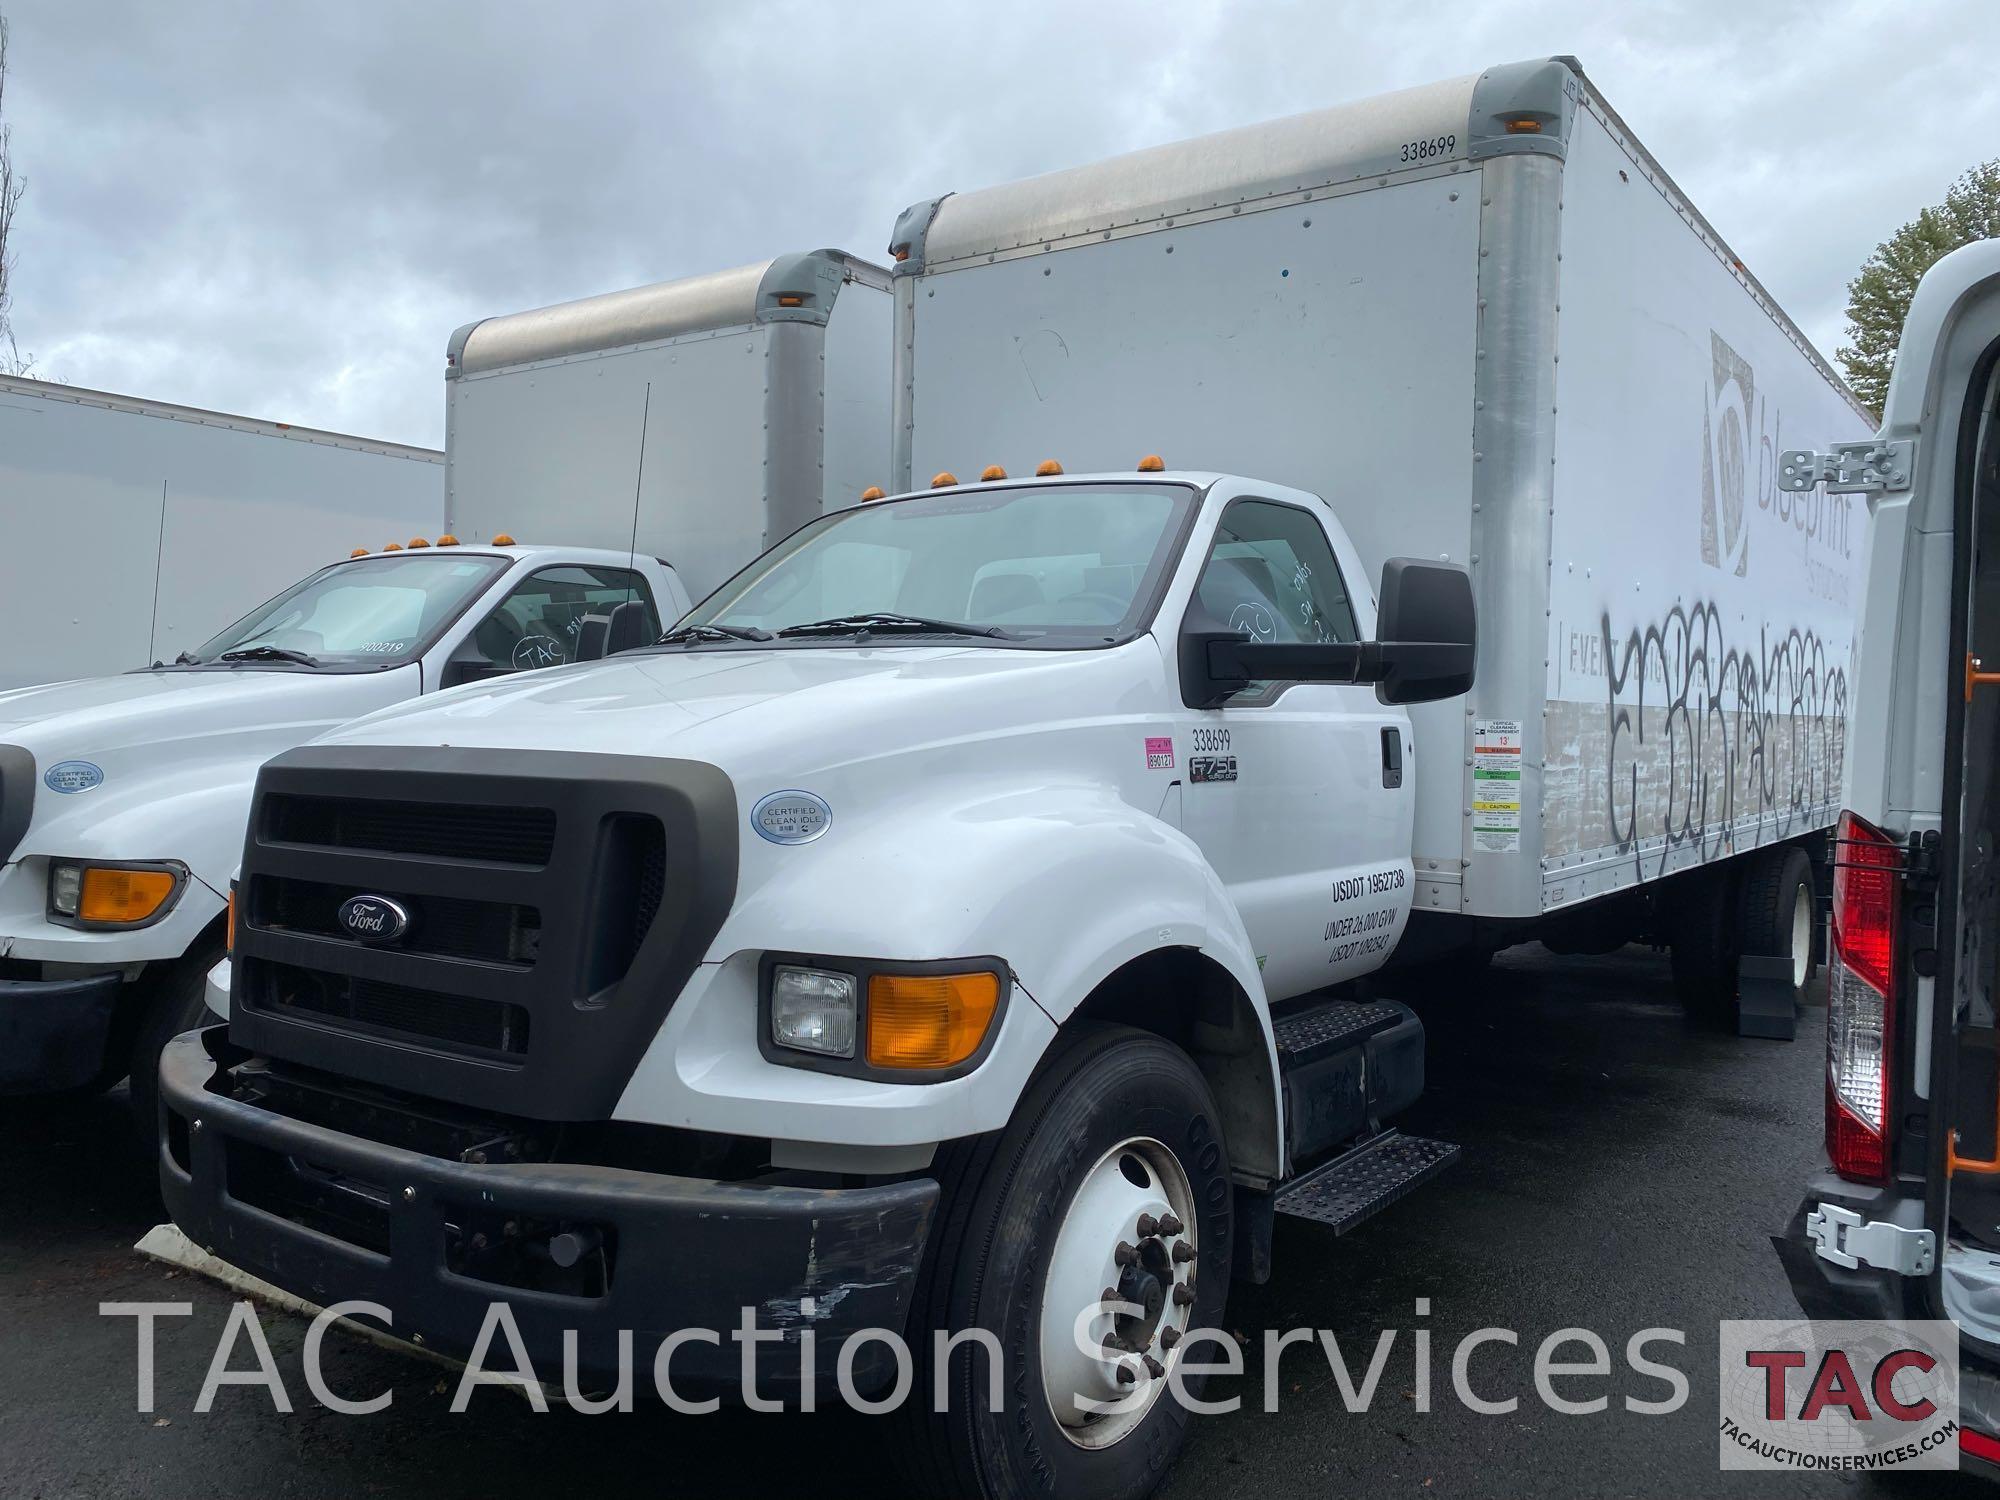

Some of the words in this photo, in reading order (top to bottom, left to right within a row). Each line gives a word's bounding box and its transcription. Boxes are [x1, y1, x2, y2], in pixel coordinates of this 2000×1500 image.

[1400, 134, 1456, 162] 338699
[360, 642, 404, 652] 900219
[519, 642, 562, 669] TAC
[1192, 728, 1231, 752] 338699
[1149, 754, 1172, 768] 890127
[763, 817, 797, 826] CLEAN
[800, 815, 822, 824] IDLE
[767, 807, 816, 816] CERTIFIED
[1332, 877, 1364, 903] USDOT
[1367, 869, 1405, 895] 1952738
[349, 903, 385, 932] Ford
[1324, 917, 1354, 941] UNDER
[1351, 911, 1379, 935] 26,000
[1379, 907, 1398, 928] GVW
[1328, 942, 1360, 964] USDOT
